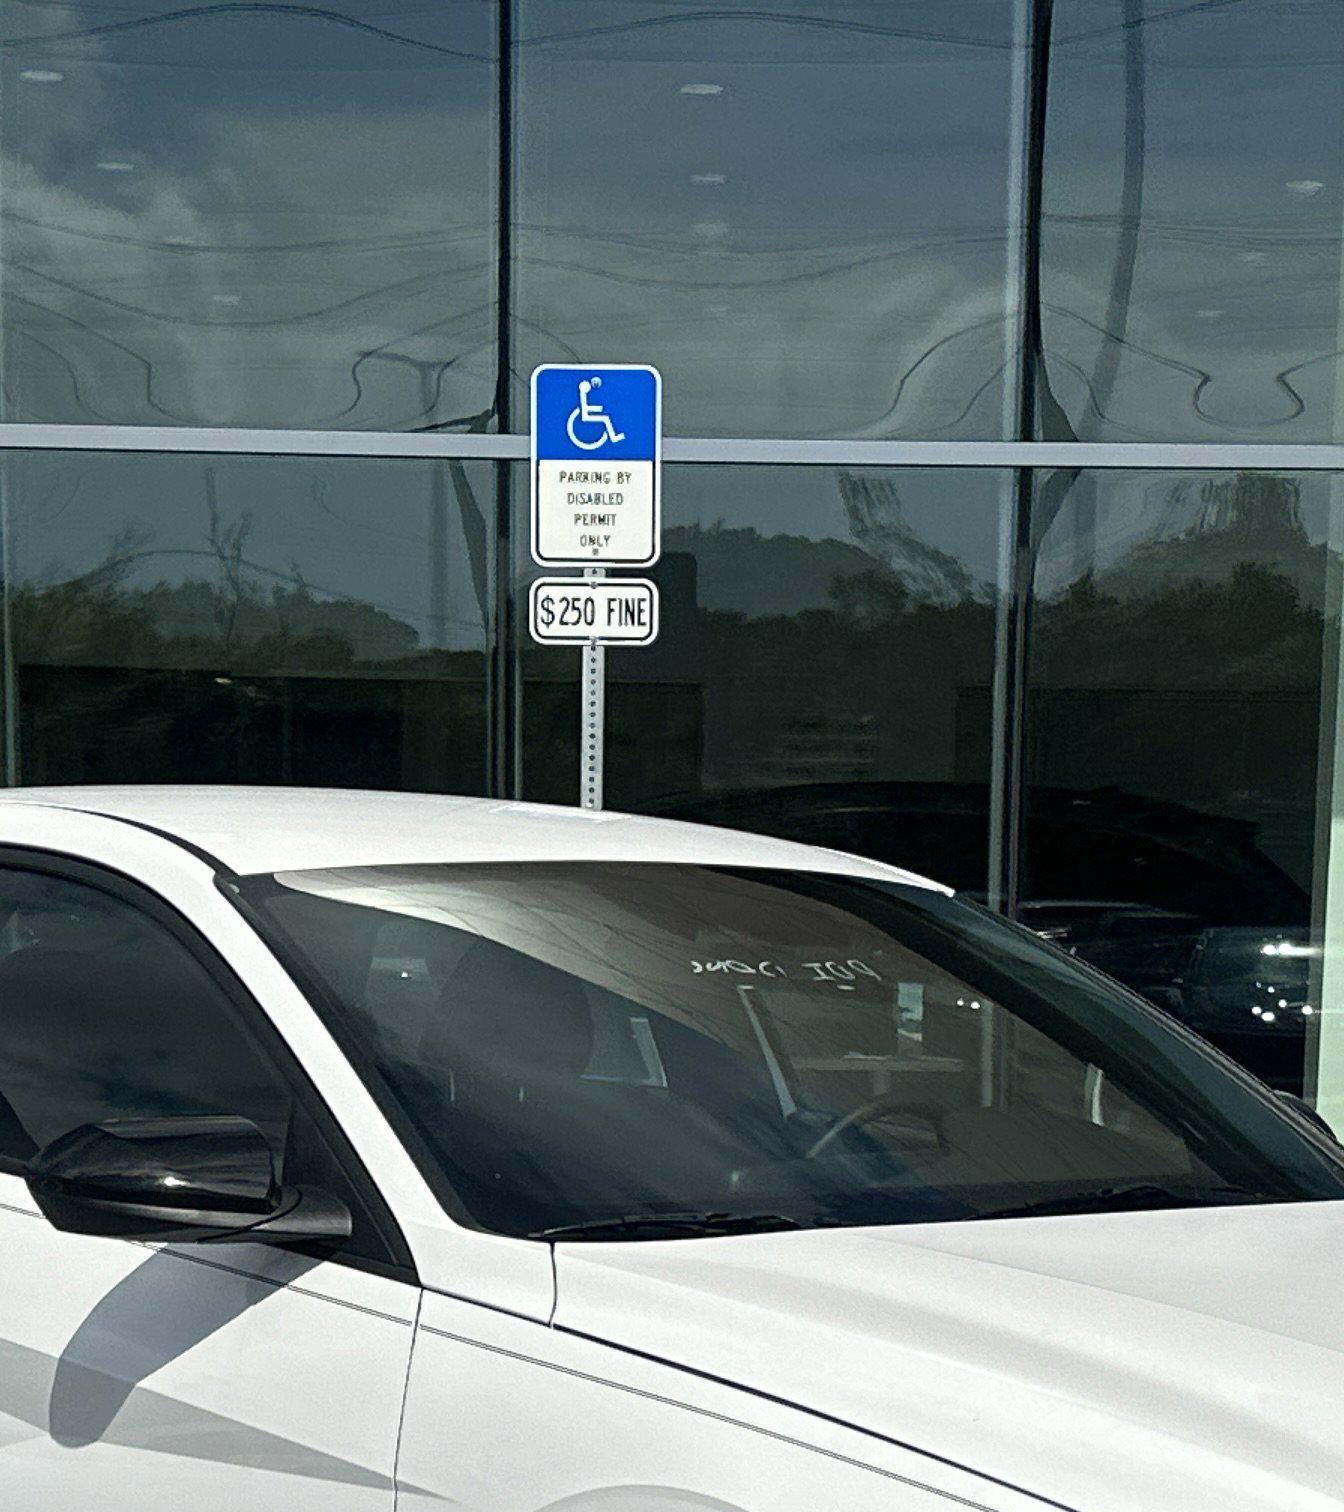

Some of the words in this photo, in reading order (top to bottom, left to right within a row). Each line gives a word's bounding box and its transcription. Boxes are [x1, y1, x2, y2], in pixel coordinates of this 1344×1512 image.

[559, 470, 612, 485] PARKING
[616, 471, 632, 485] BY
[567, 492, 624, 506] DISABLED
[574, 513, 617, 526] PERMIT
[579, 534, 611, 548] ONLY
[540, 594, 595, 629] $250
[606, 597, 647, 627] FINE
